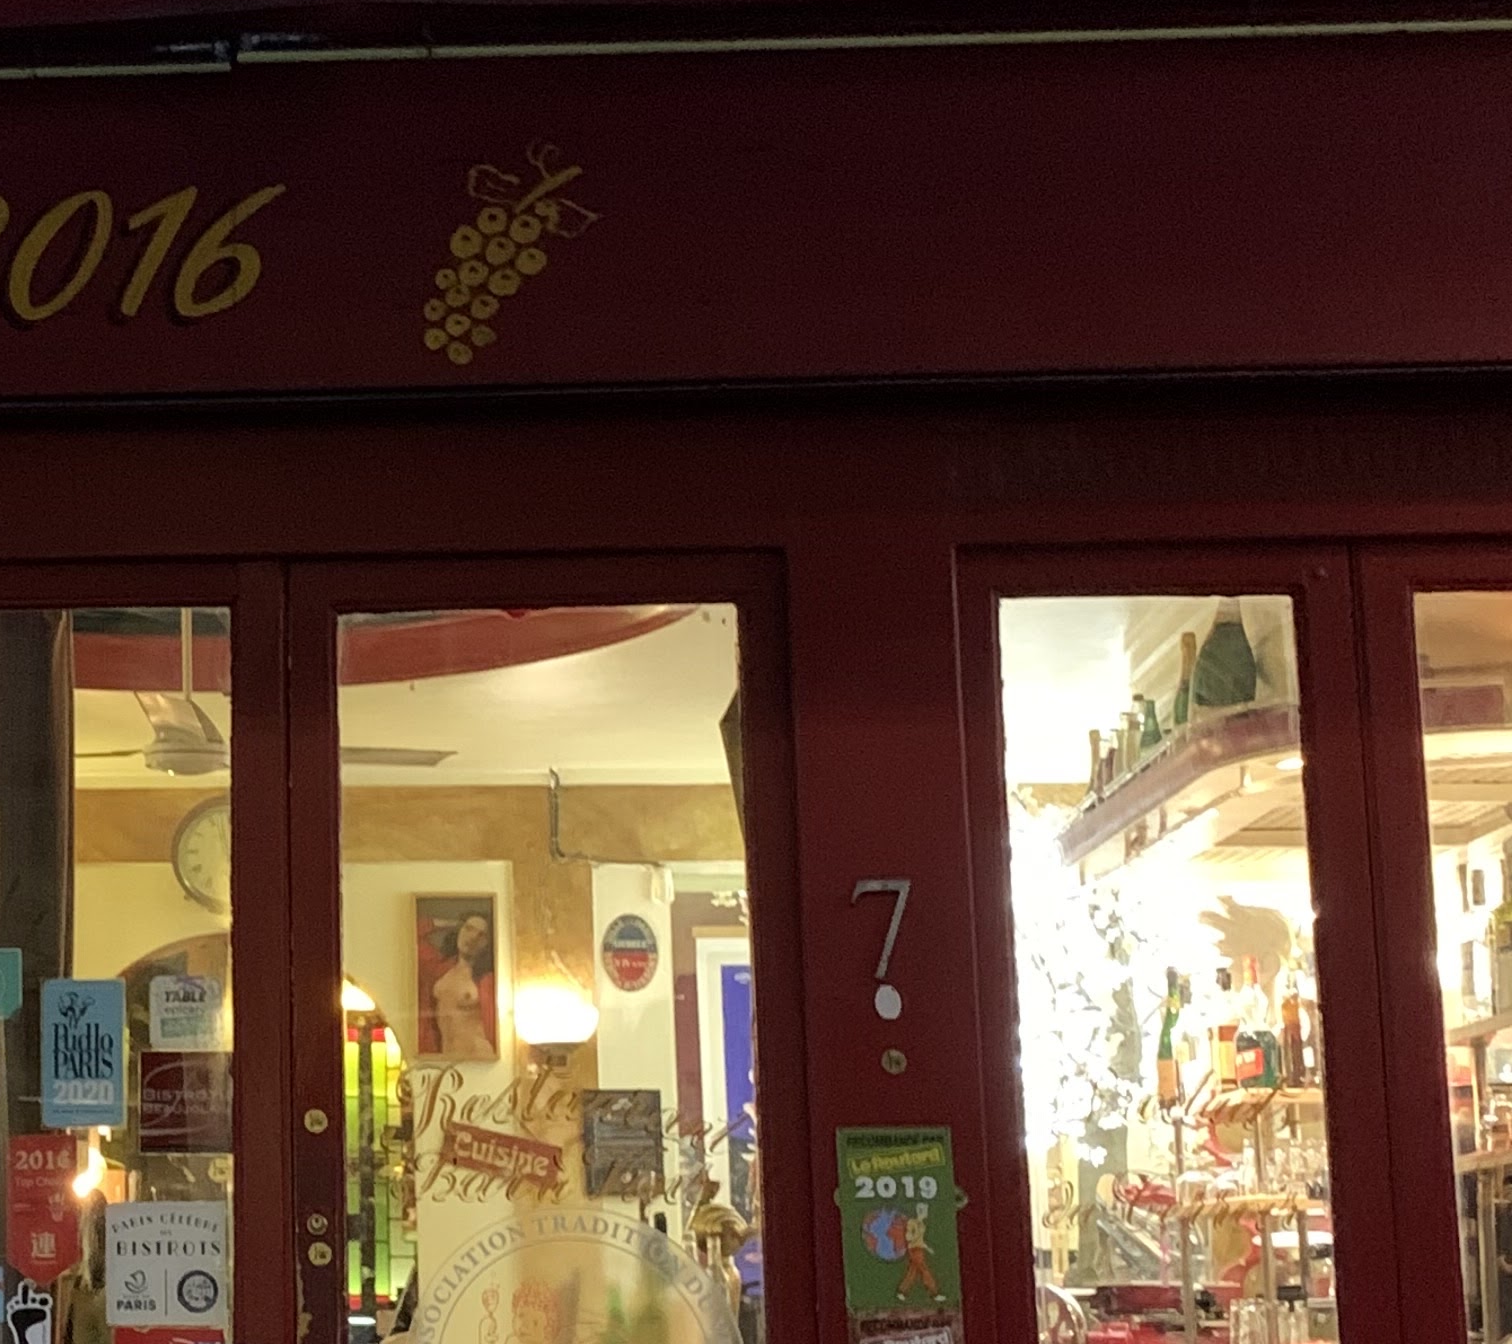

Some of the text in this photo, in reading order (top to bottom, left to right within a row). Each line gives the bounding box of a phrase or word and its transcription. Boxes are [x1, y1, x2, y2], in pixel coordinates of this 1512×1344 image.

[849, 879, 912, 980] 7
[53, 1051, 114, 1080] PARIS
[52, 1079, 115, 1105] 2020
[452, 1132, 551, 1178] Cuisine
[854, 1175, 938, 1199] 2019
[116, 1240, 221, 1257] BISTROTS
[116, 1299, 157, 1312] PARIS
